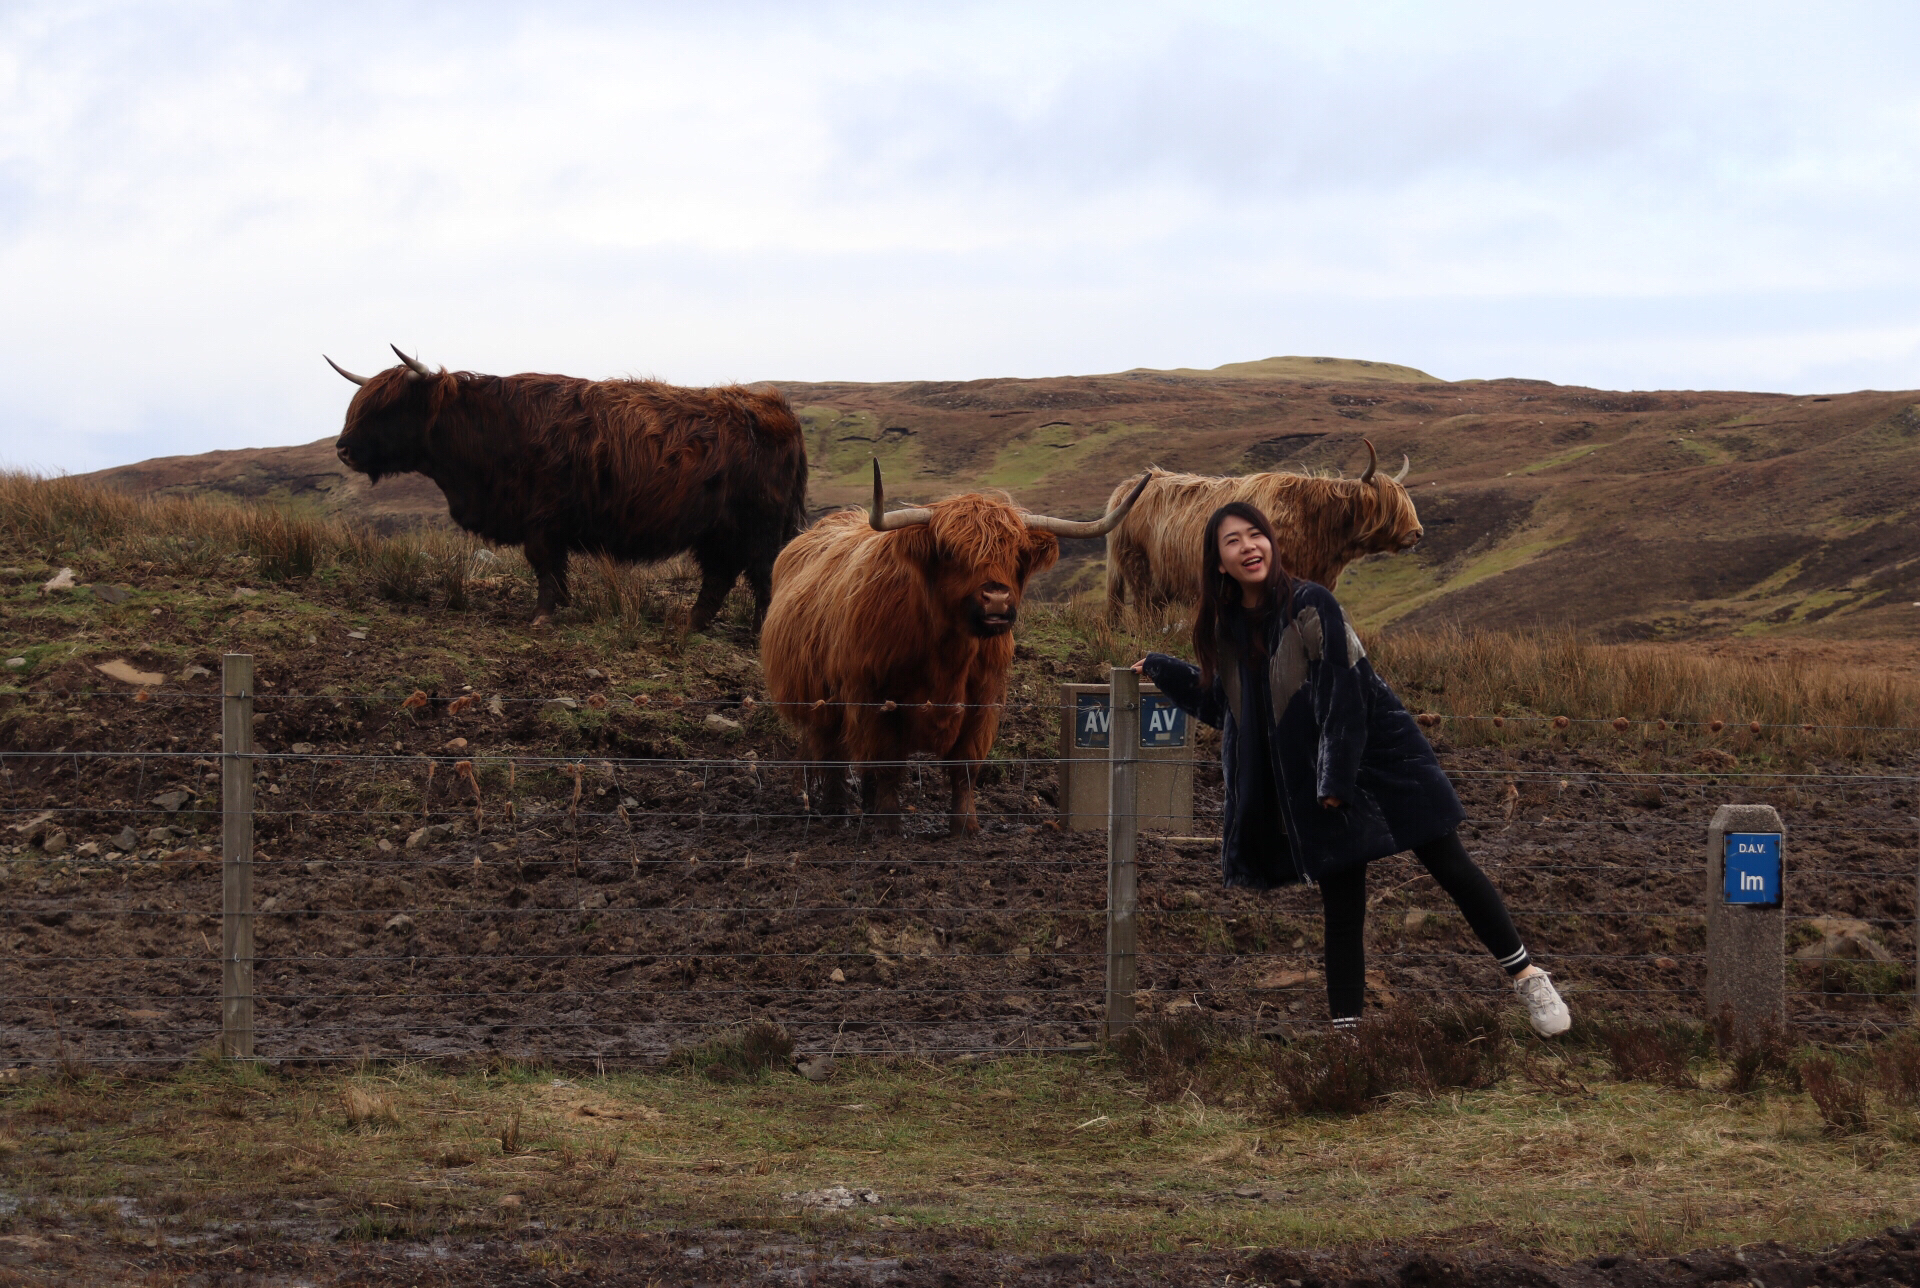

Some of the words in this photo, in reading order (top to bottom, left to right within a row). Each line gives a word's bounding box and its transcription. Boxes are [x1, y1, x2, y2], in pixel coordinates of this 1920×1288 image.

[1085, 711, 1110, 732] AV
[1149, 708, 1178, 731] AV
[1739, 843, 1766, 854] D.A.V.
